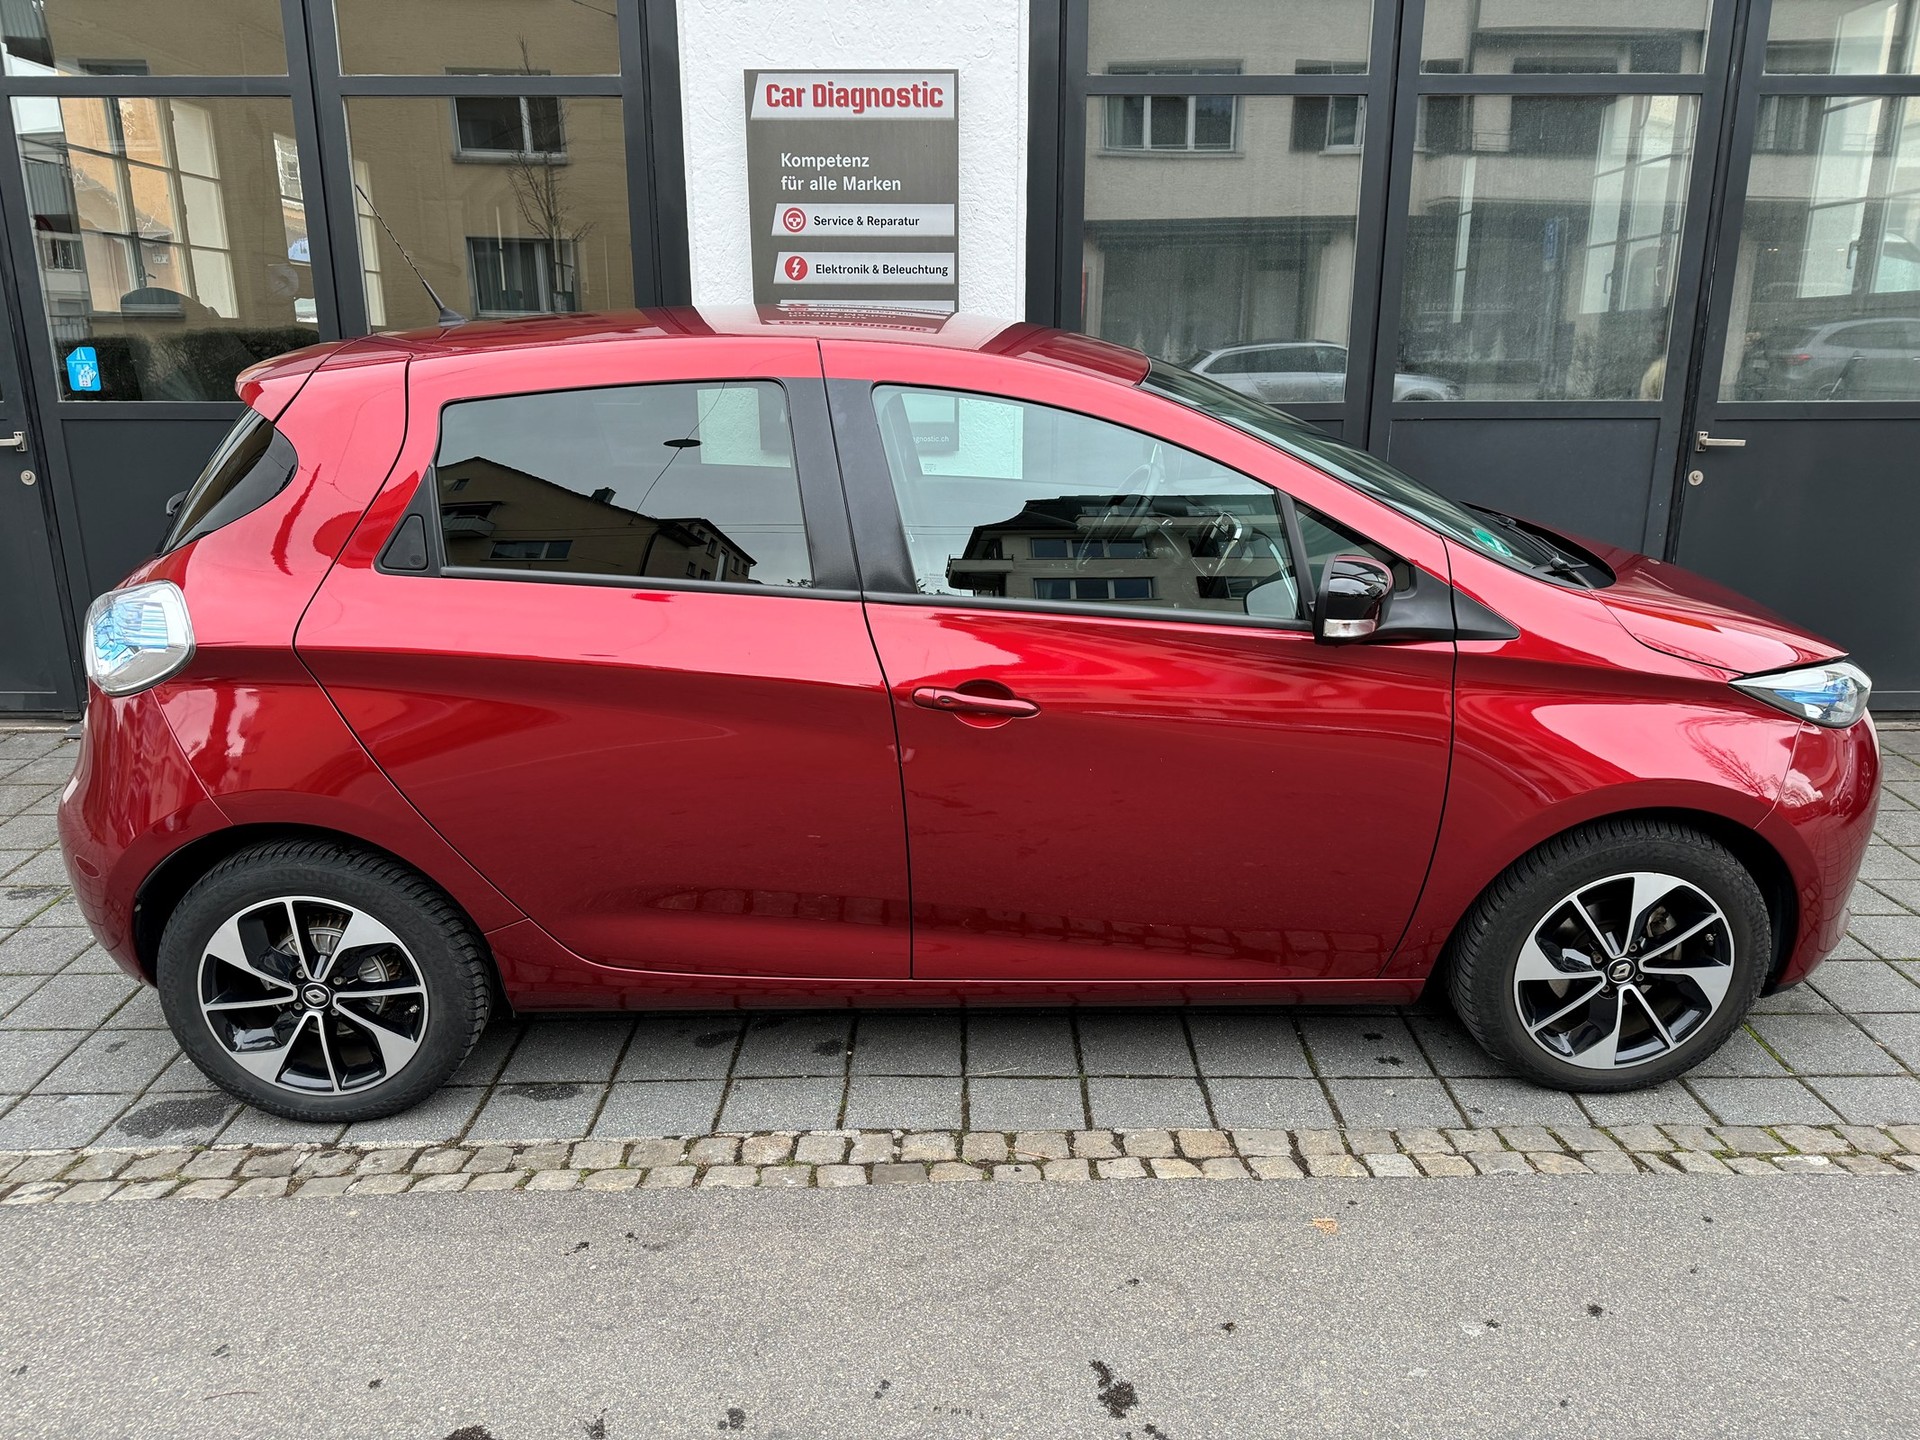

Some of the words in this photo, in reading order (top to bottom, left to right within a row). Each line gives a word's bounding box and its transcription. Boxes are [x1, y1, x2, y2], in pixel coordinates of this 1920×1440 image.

[766, 83, 806, 107] Car
[812, 81, 943, 114] Diagnostic
[780, 152, 869, 171] Kompetenz
[781, 176, 804, 191] für
[809, 176, 837, 191] alle
[843, 176, 901, 191] Marken
[813, 215, 854, 226] Service
[856, 215, 864, 226] &
[867, 215, 920, 229] Reparatur
[815, 264, 869, 275] Elektronik
[872, 264, 880, 275] &
[882, 264, 948, 277] Beleuchtung
